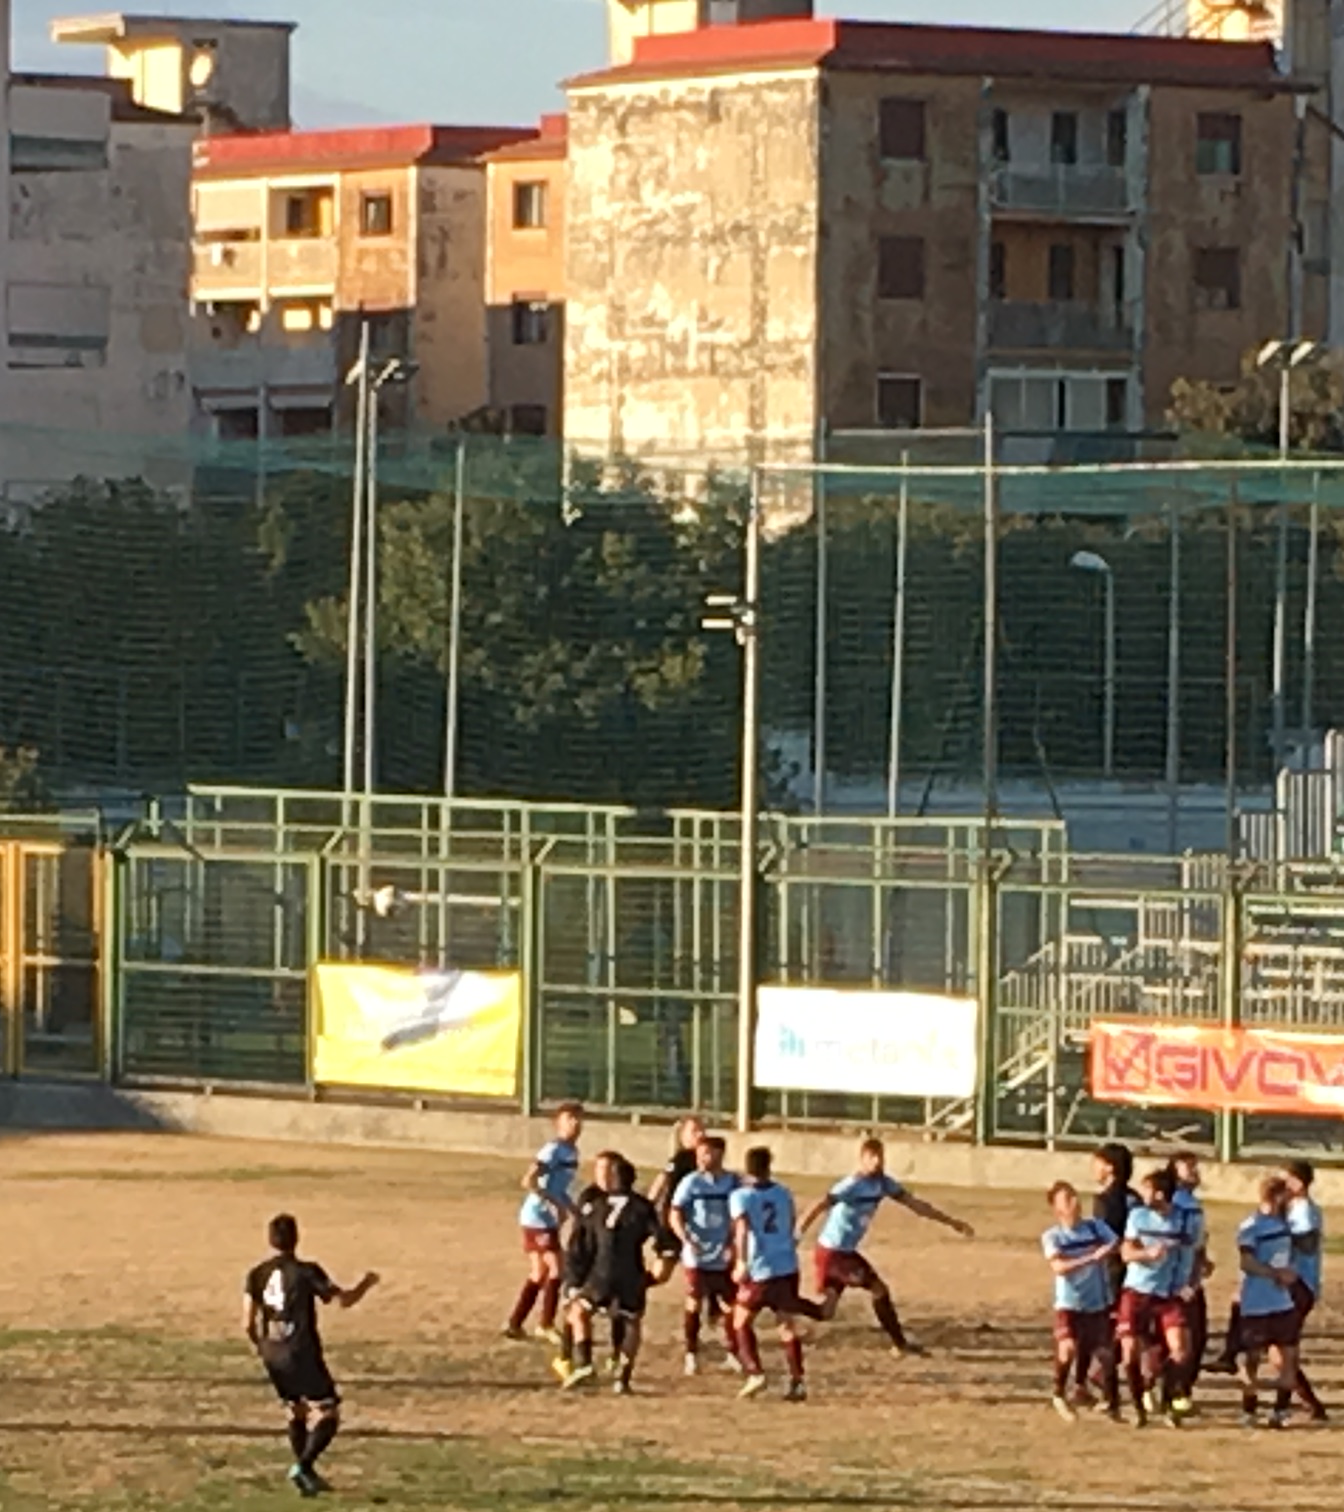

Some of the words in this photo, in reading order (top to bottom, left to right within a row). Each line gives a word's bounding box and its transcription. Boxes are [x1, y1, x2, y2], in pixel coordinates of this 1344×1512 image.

[606, 1195, 629, 1229] 7
[762, 1202, 778, 1234] 2
[262, 1268, 285, 1312] 4
